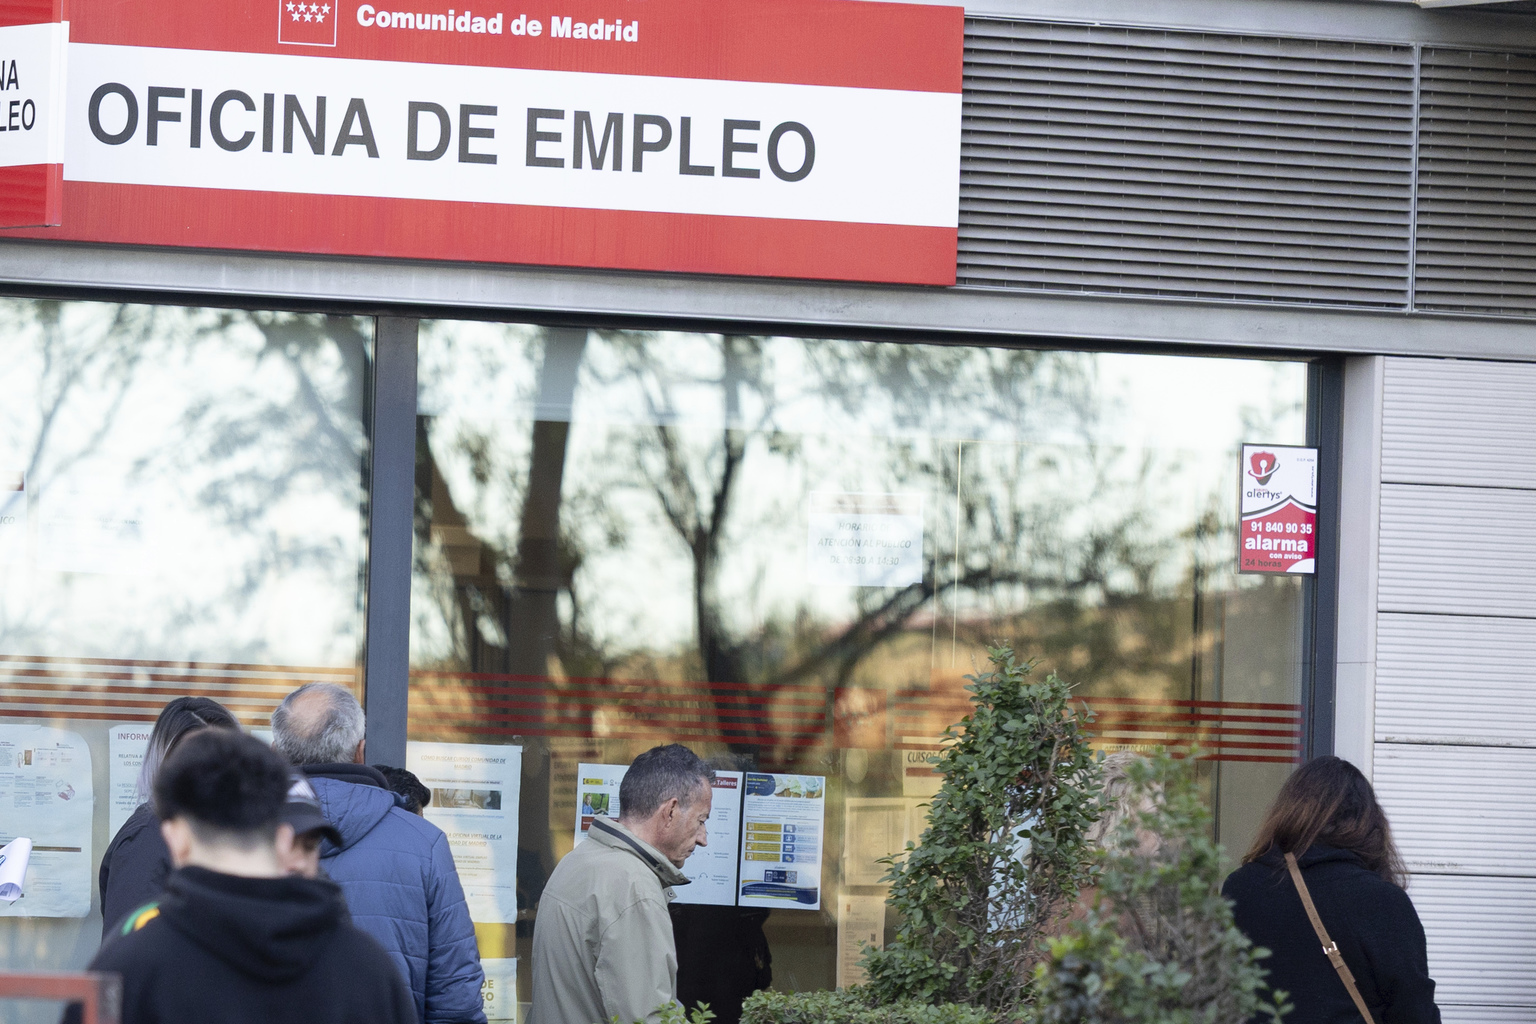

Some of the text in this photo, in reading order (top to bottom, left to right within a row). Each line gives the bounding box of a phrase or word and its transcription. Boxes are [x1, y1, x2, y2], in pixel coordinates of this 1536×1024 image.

[356, 4, 639, 42] Comunidad de Madrid
[86, 82, 817, 183] OFICINA DE EMPLEO
[1246, 488, 1281, 501] alertys
[1250, 521, 1313, 535] 91 840 90 35
[817, 537, 862, 548] ATENCIÓN
[1245, 534, 1308, 552] alarma
[877, 556, 900, 566] 14:30
[1258, 559, 1282, 567] horas
